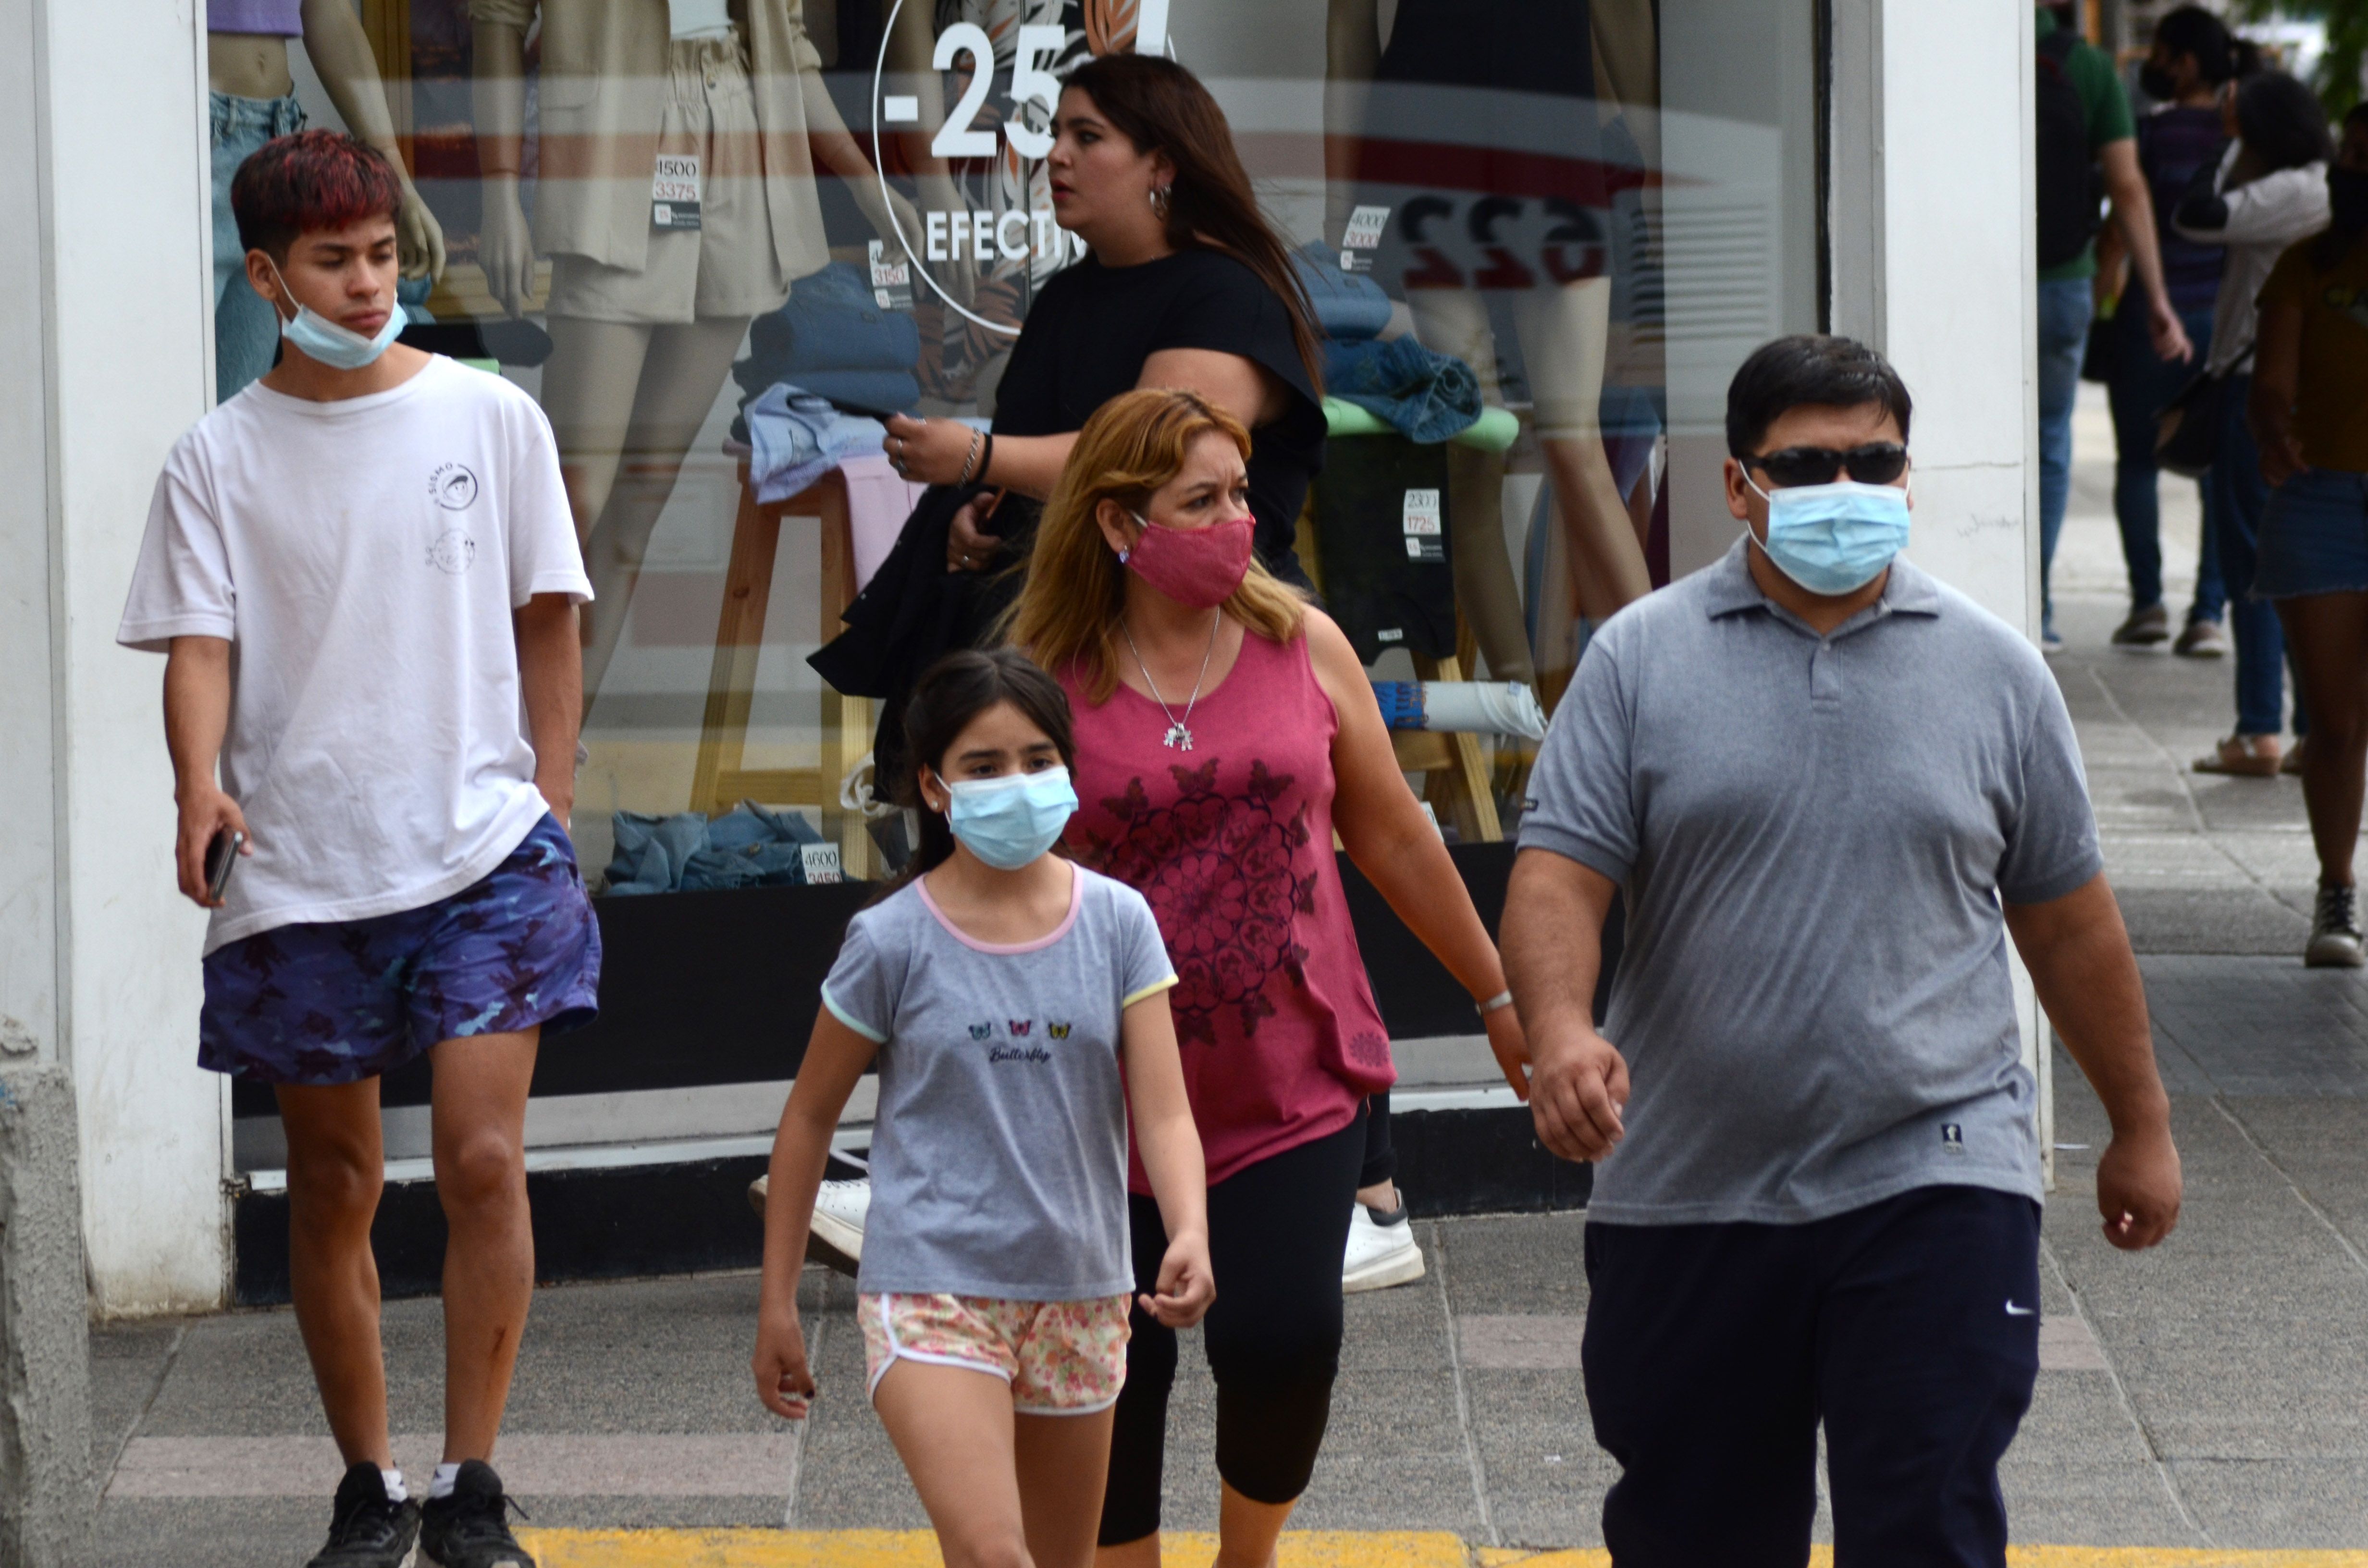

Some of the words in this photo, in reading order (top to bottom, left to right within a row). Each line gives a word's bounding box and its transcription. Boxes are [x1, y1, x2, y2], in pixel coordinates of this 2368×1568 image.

[655, 181, 696, 201] 3375
[875, 268, 905, 285] 3150
[1407, 515, 1435, 532] 1725
[805, 850, 837, 868] 4600
